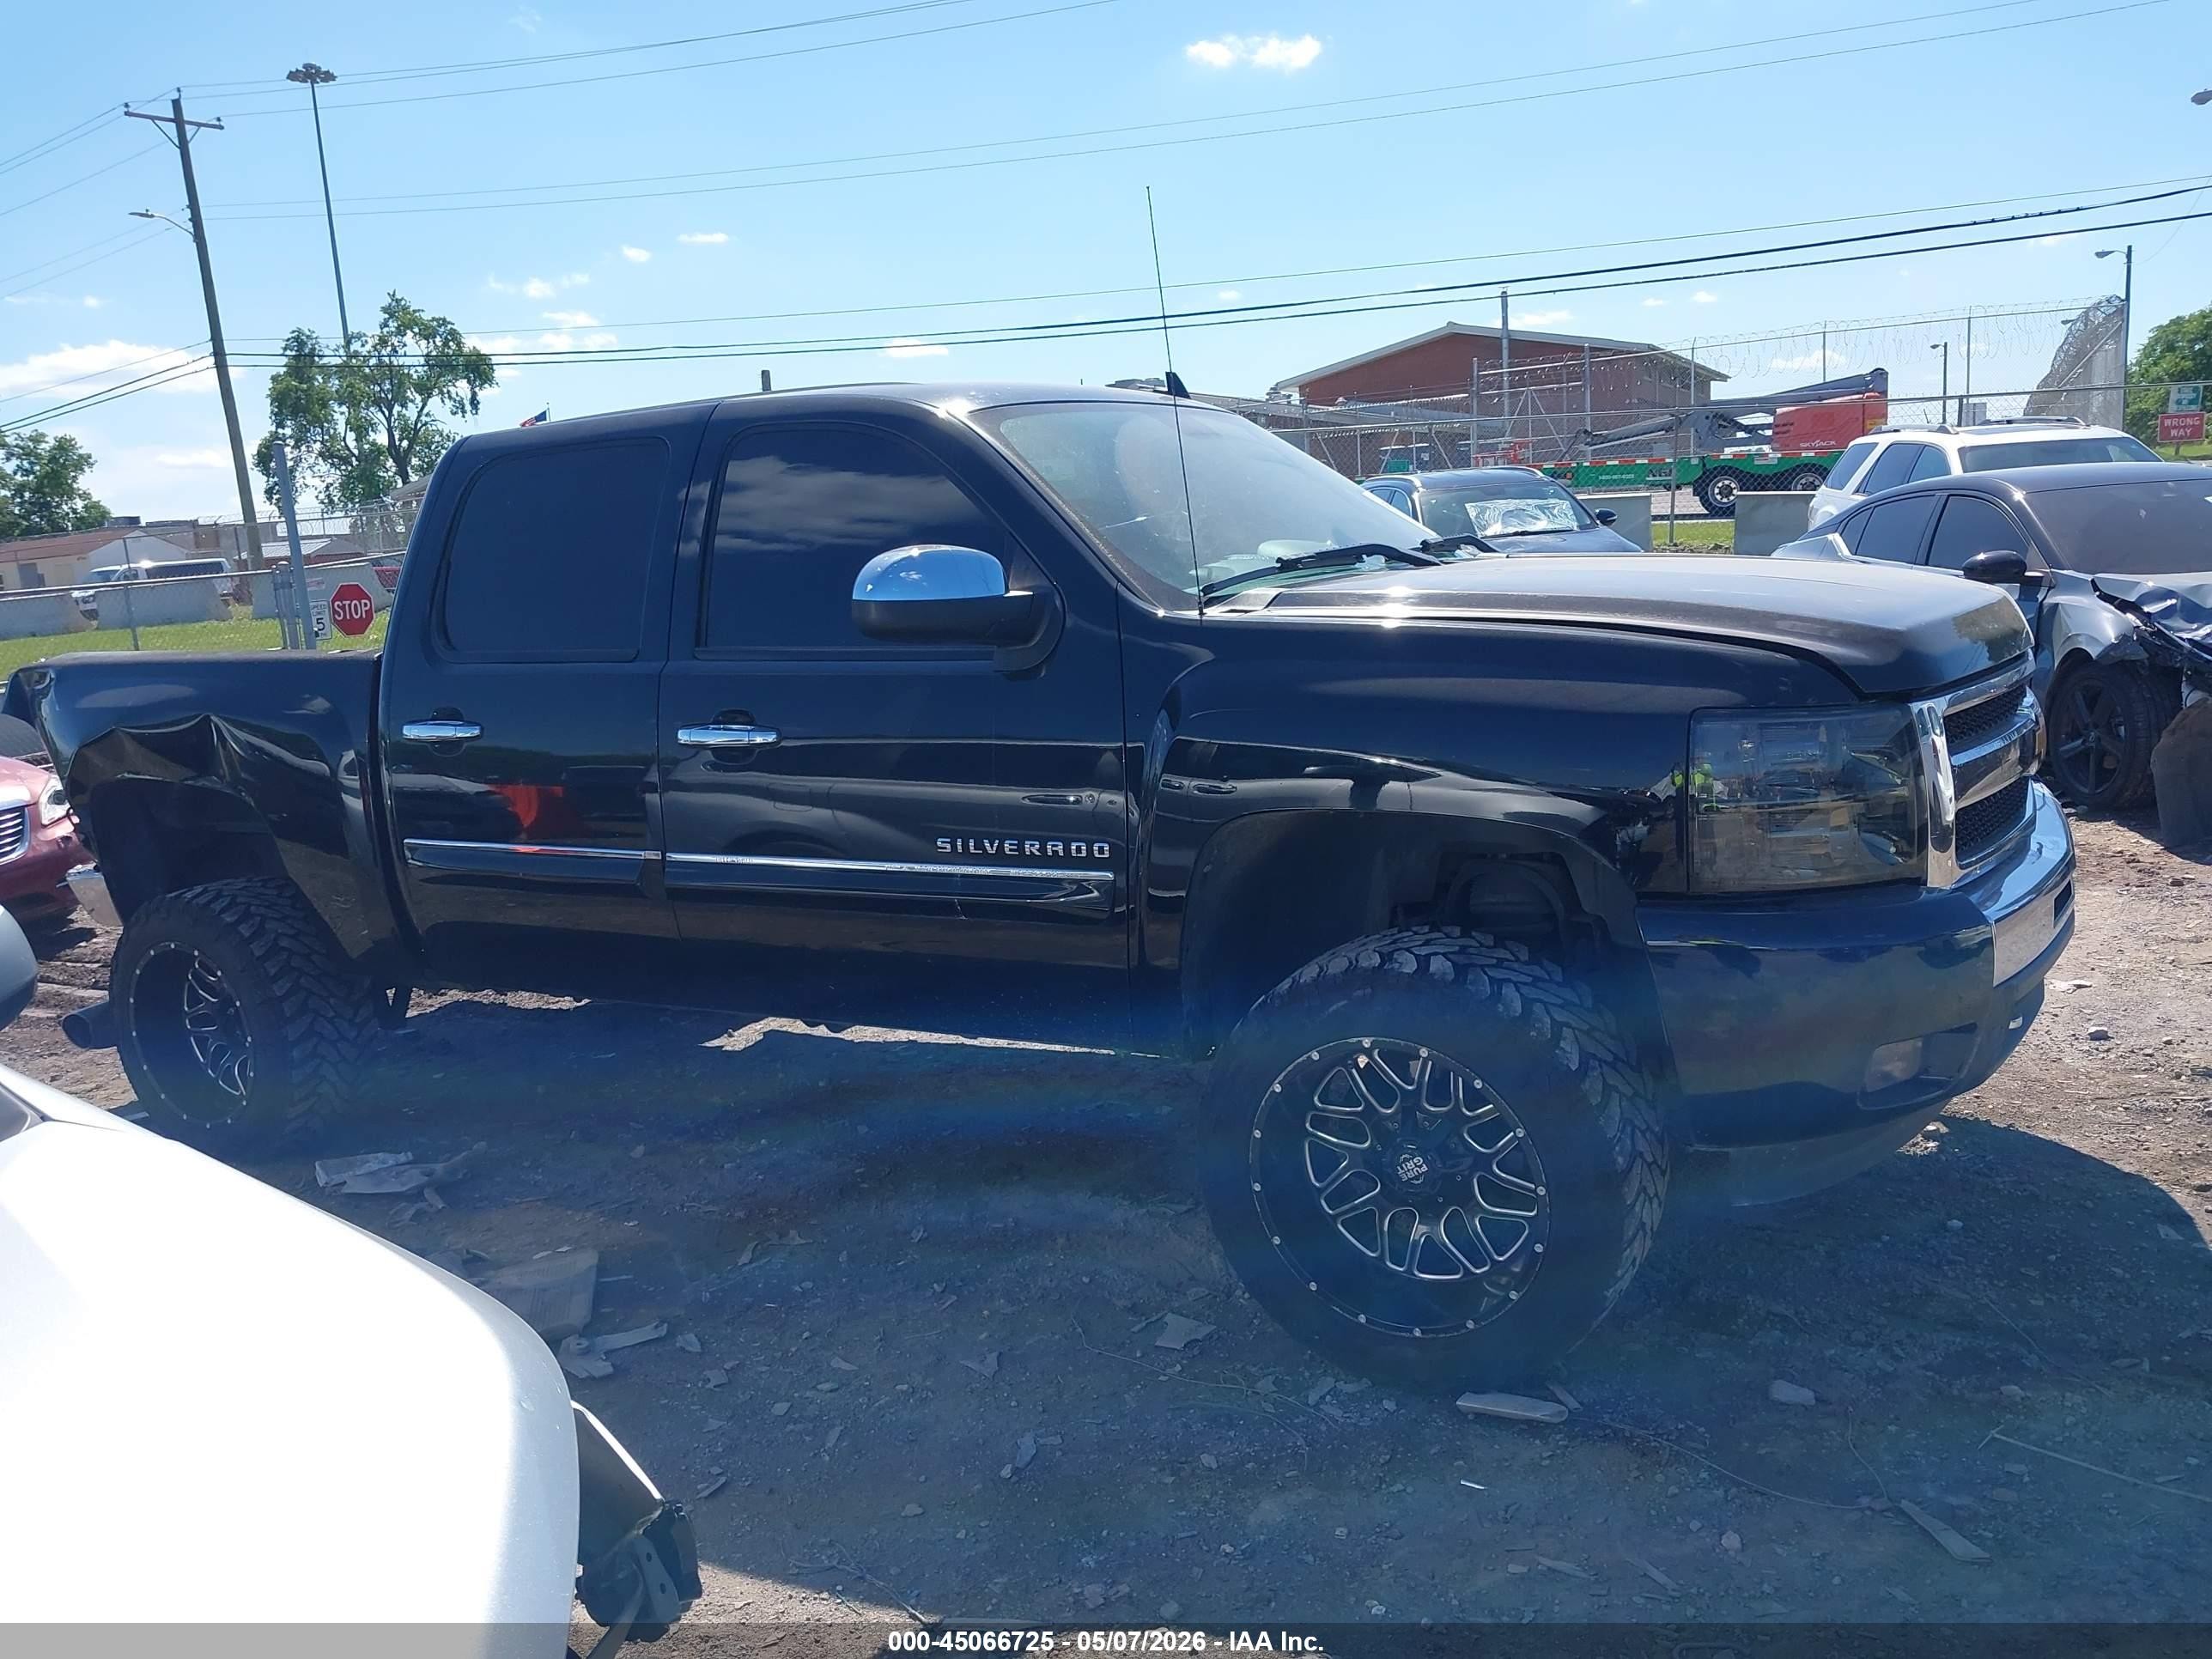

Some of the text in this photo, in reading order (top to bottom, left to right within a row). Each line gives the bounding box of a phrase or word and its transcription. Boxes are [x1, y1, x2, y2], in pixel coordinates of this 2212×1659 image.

[2164, 416, 2200, 427] WRONG
[2170, 428, 2192, 437] WAY
[1799, 440, 1837, 448] SKYJACK
[334, 599, 371, 620] STOP
[316, 617, 325, 631] 5
[936, 837, 1110, 858] SILVERADO
[1396, 1156, 1424, 1175] GRIT
[1399, 1164, 1429, 1182] PURE
